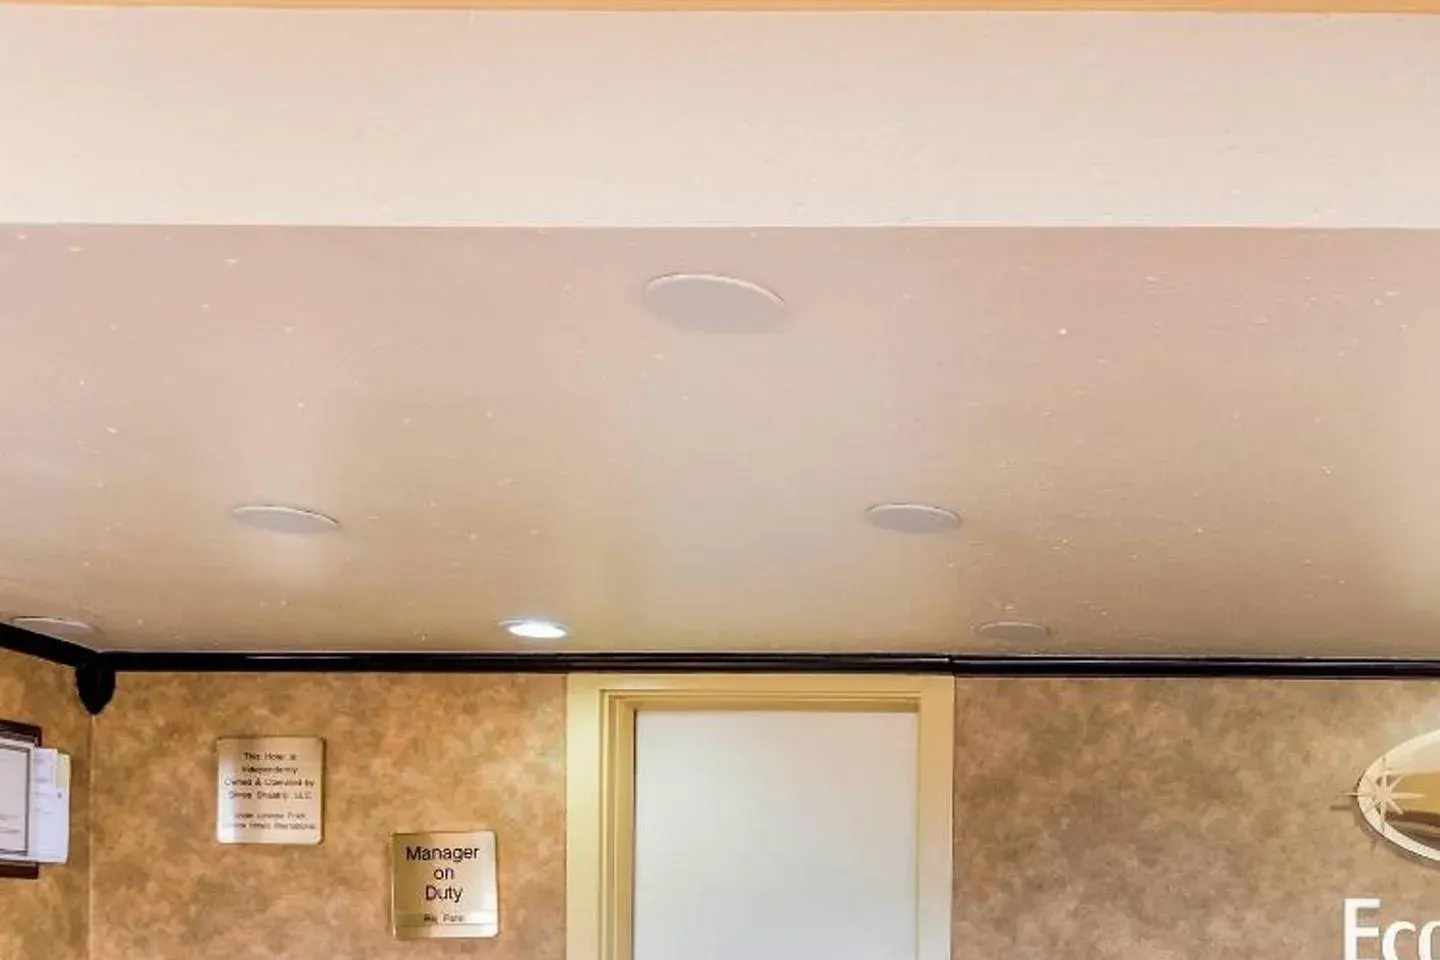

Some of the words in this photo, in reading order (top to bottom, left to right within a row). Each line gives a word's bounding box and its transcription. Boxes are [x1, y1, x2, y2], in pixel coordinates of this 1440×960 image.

[406, 846, 480, 862] Manager
[433, 868, 455, 880] on
[425, 885, 463, 903] Duty
